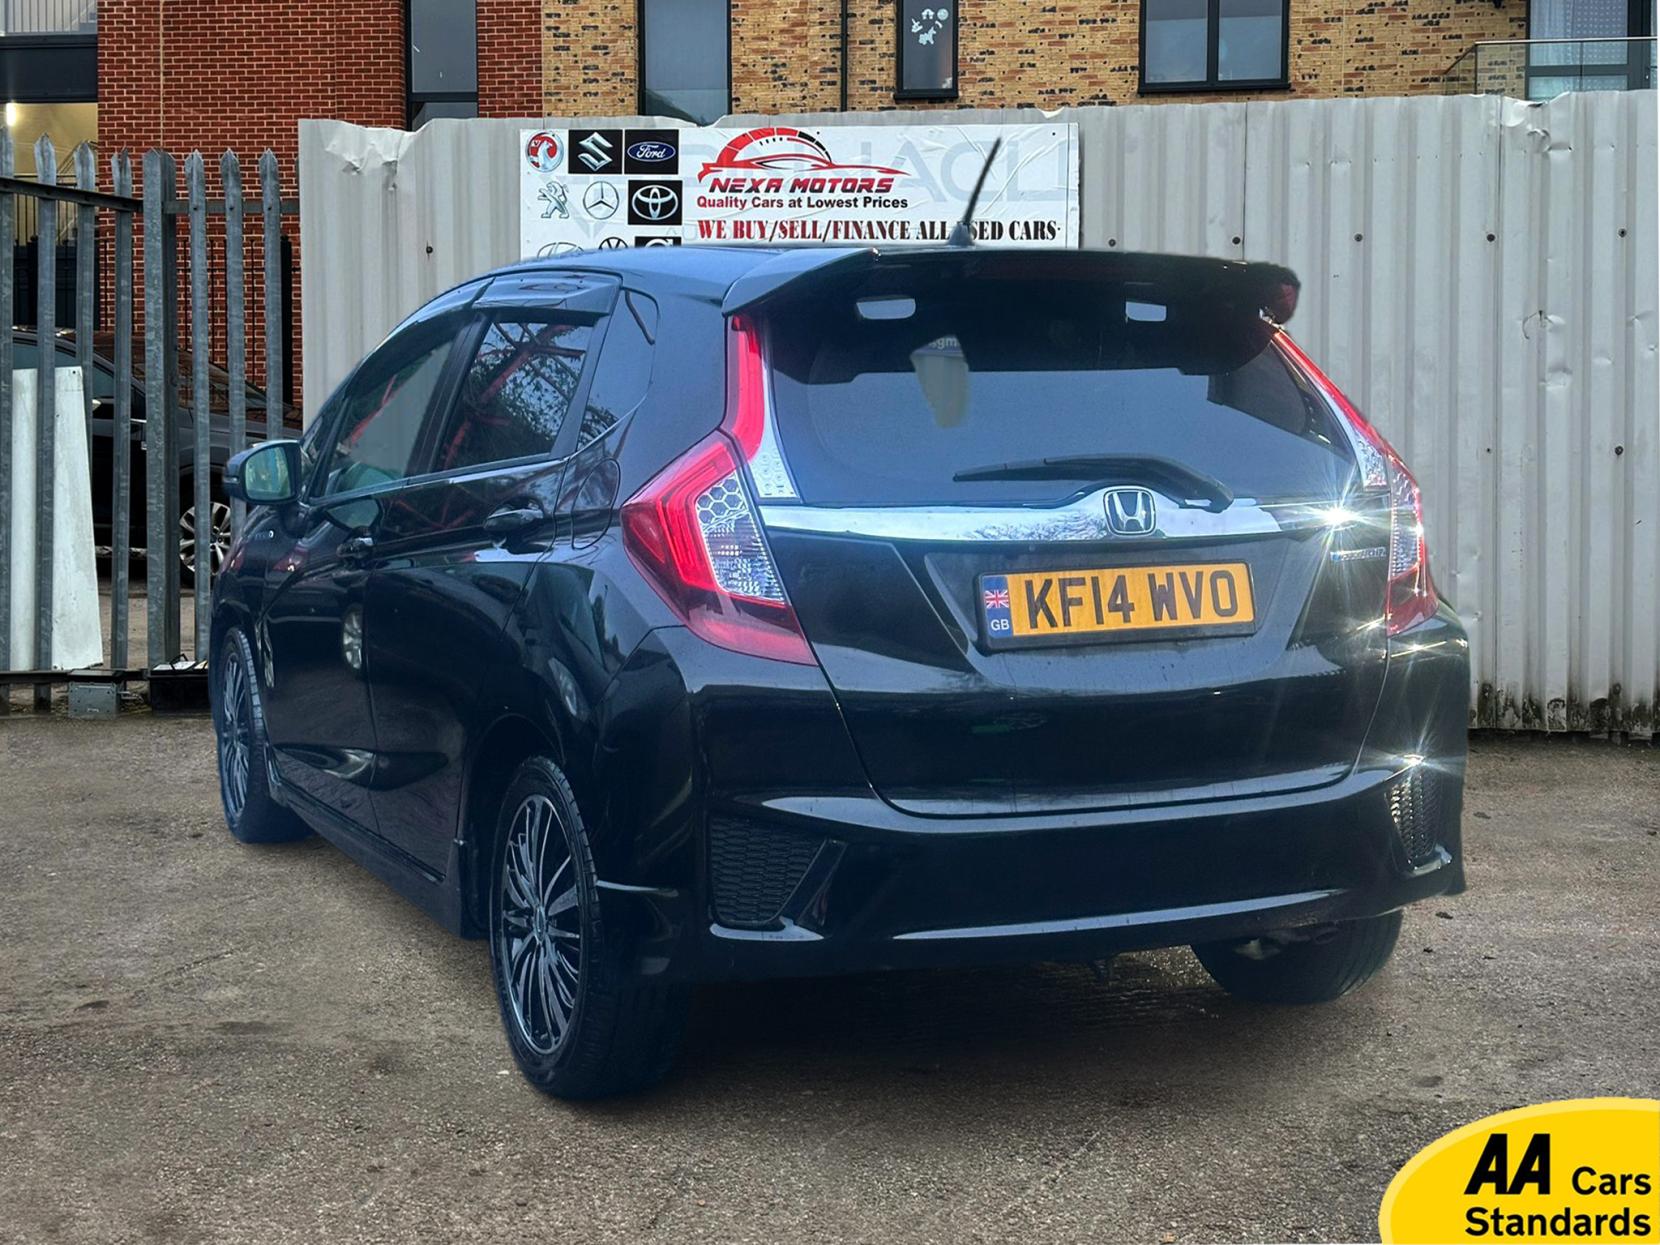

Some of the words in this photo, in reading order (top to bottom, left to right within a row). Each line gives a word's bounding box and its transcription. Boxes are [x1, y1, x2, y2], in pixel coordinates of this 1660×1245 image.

[636, 144, 666, 159] Ford
[708, 177, 784, 193] NEXA
[789, 177, 894, 193] MOTORS
[696, 195, 747, 211] Quality
[751, 196, 784, 208] Cars
[788, 197, 802, 208] at
[806, 196, 859, 208] Lowest
[863, 195, 908, 208] Prices
[697, 219, 727, 240] WE
[916, 220, 950, 240] ALL
[957, 220, 1004, 240] SED
[1008, 220, 1058, 241] CARS
[1025, 574, 1135, 630] KF14
[1147, 569, 1239, 622] WVO
[990, 618, 1010, 632] GB
